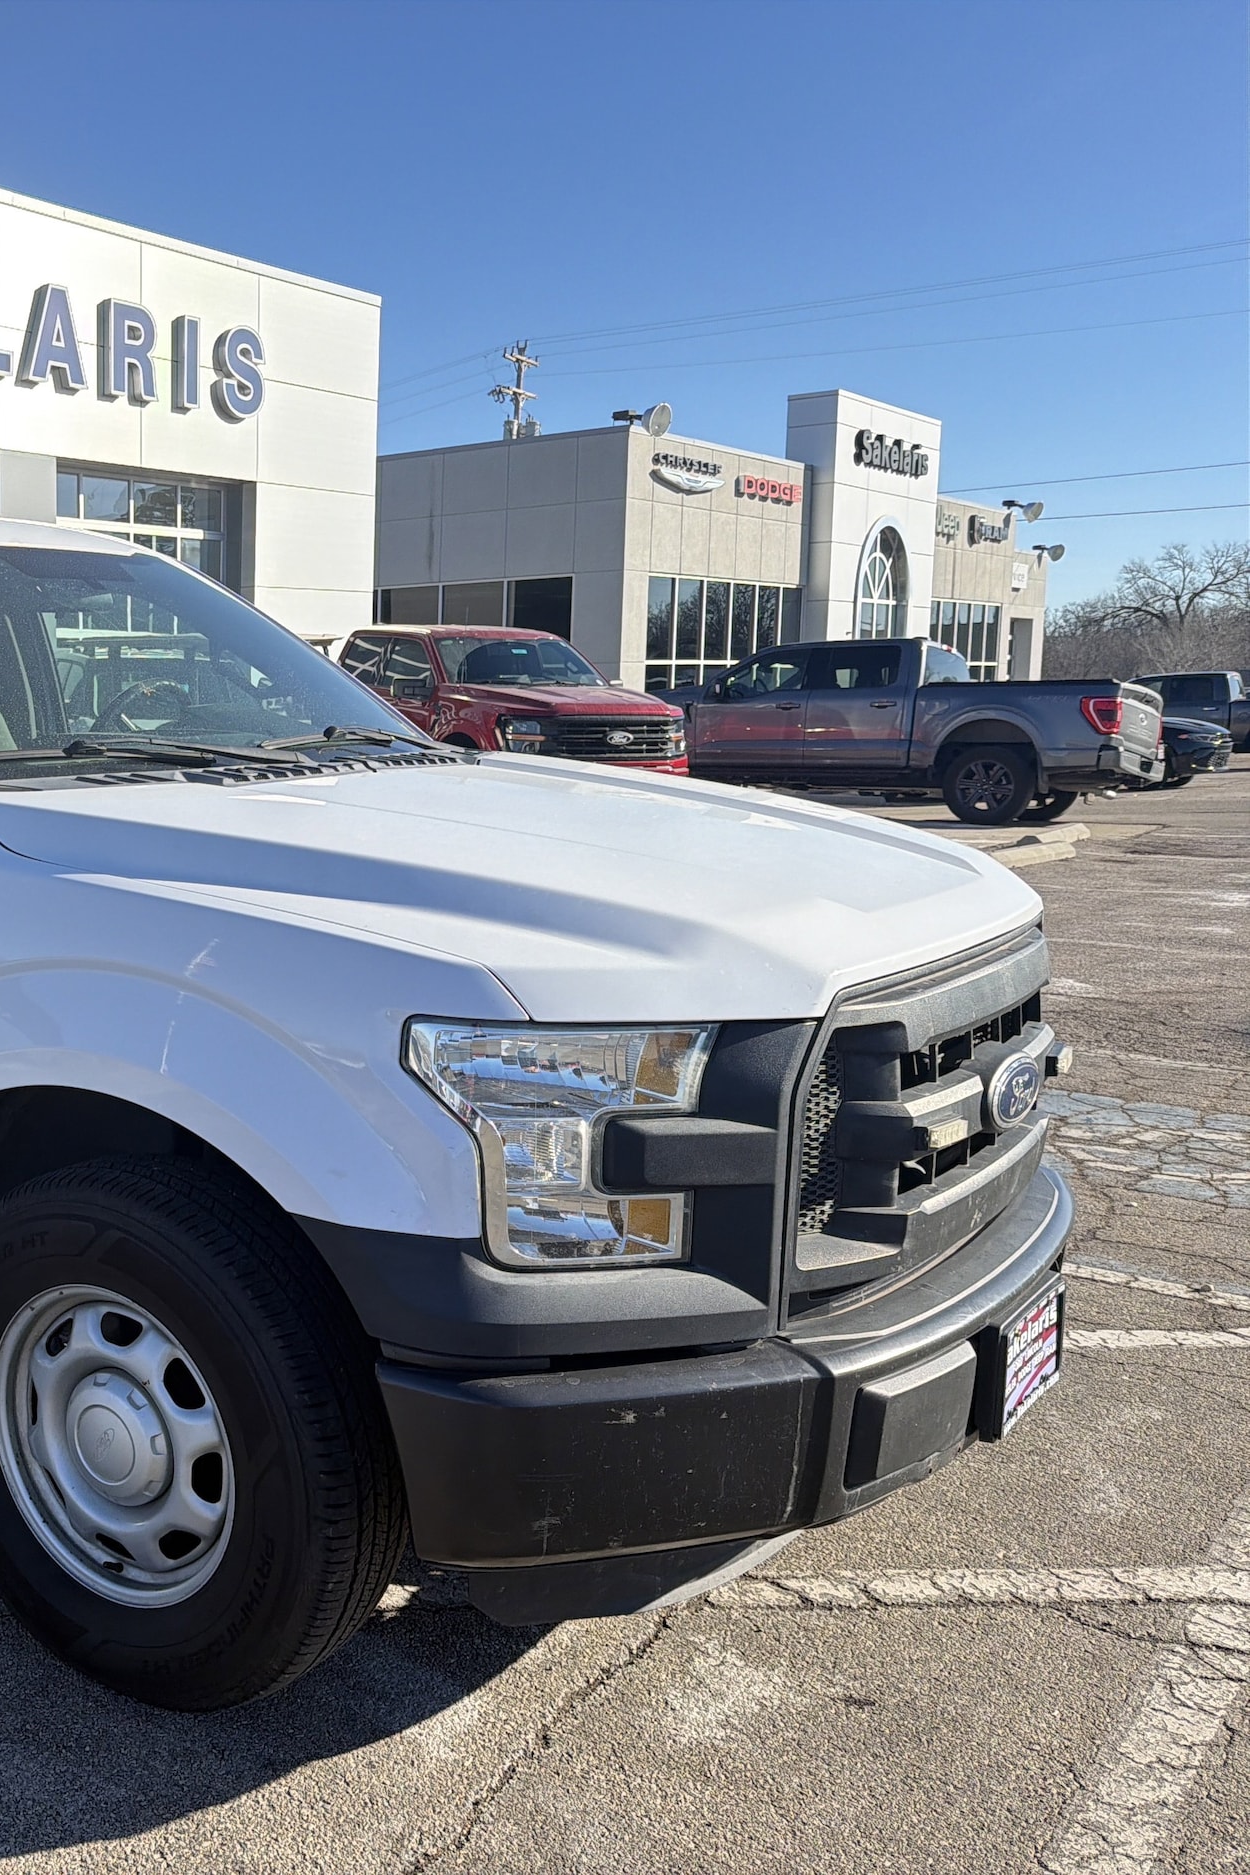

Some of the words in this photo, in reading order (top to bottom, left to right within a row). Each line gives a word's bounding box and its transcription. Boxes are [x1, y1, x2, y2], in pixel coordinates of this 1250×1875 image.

[652, 452, 722, 476] CHRYSLER
[854, 429, 928, 476] Sakelaris
[735, 475, 802, 503] DODGE
[936, 504, 960, 538] Jeep
[984, 524, 1009, 541] RAM
[21, 1231, 49, 1250] HT
[1007, 1303, 1058, 1367] akelaris
